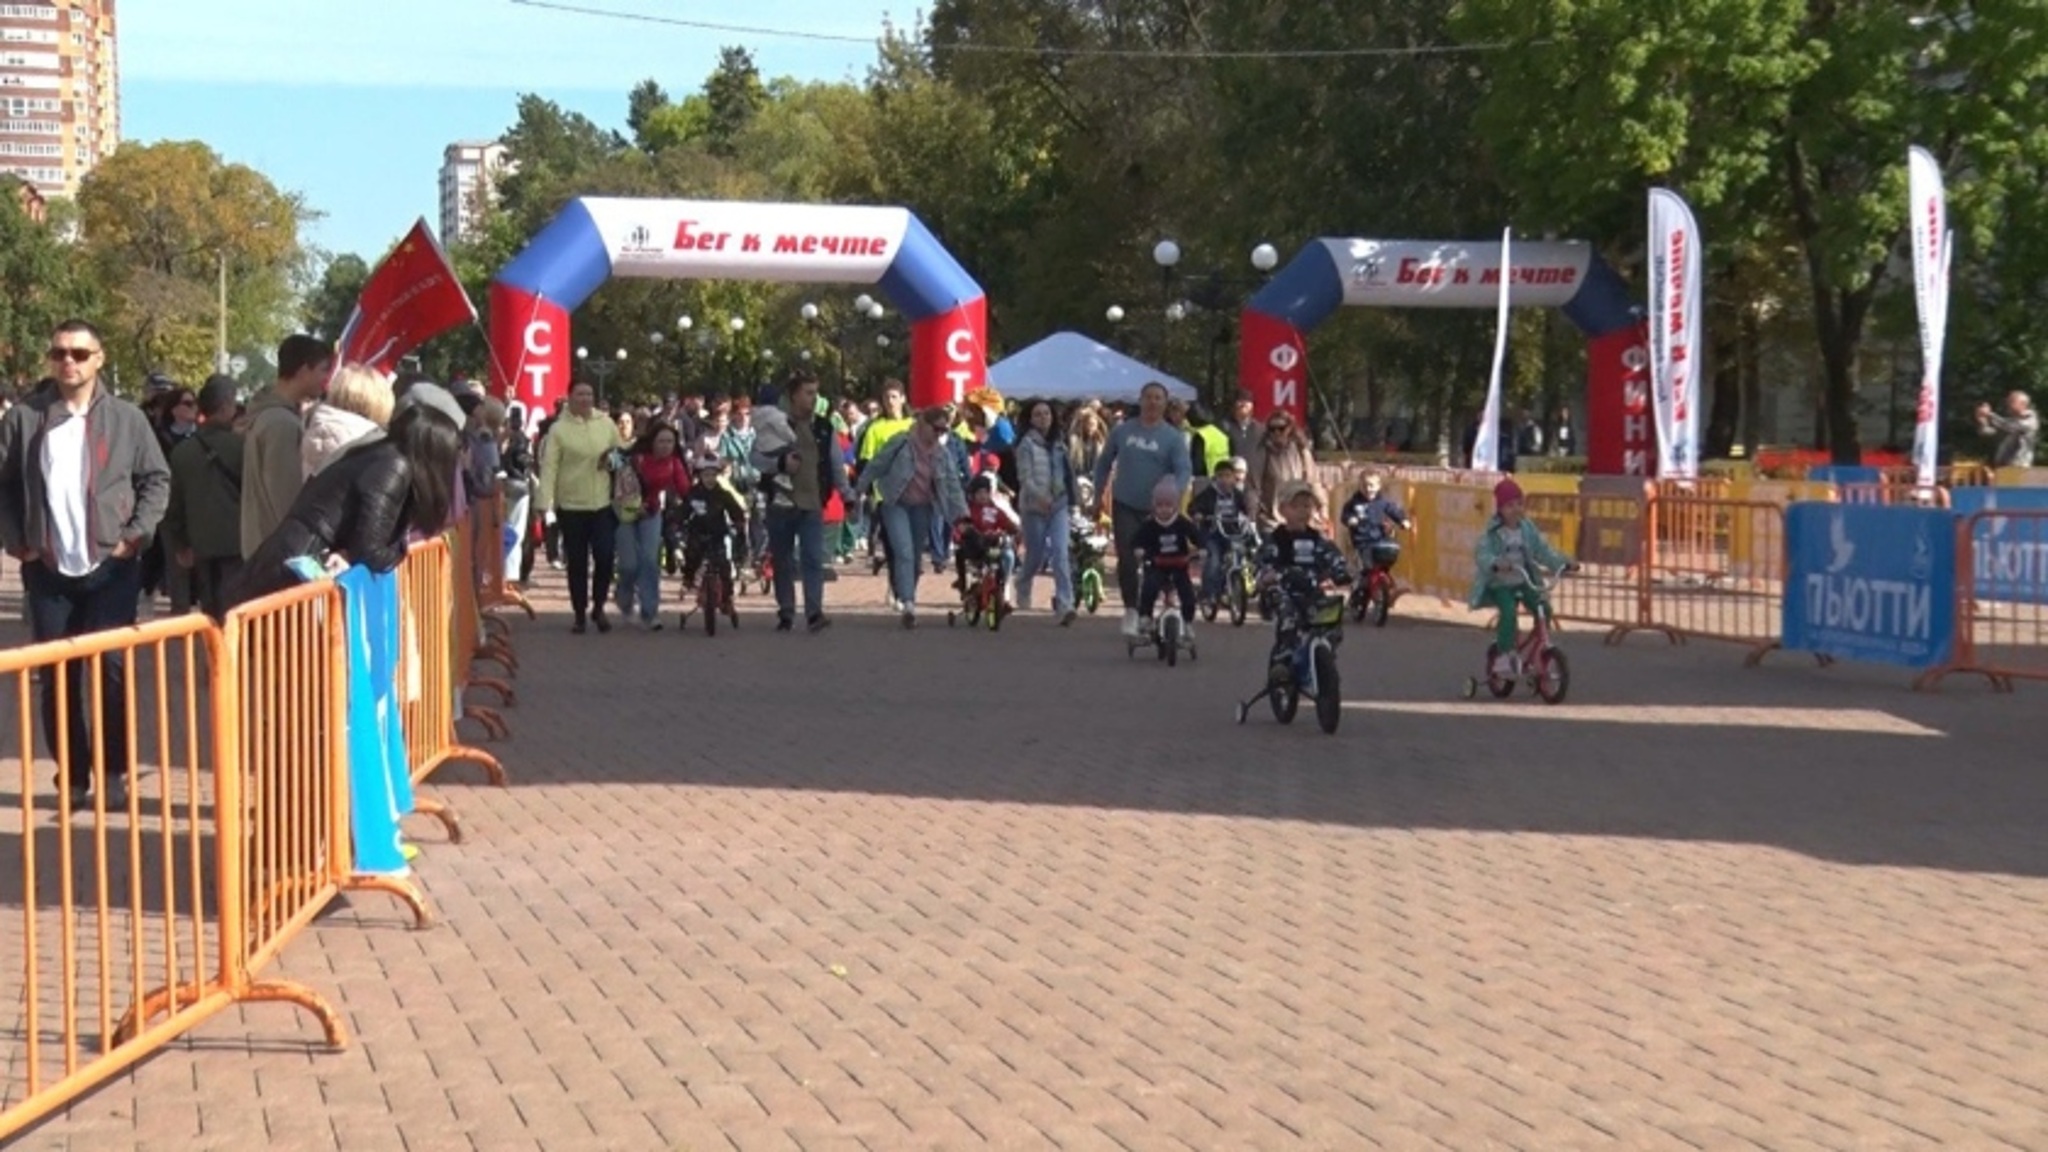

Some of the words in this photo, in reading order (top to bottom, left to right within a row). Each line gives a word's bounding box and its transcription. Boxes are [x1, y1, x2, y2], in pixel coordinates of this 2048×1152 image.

[673, 219, 731, 251] Бег
[741, 234, 760, 252] к
[773, 233, 887, 256] мечте
[1453, 269, 1470, 285] к
[1972, 540, 2048, 584] ПЬЮТТ
[1805, 573, 1931, 640] ПЬЮТТИ
